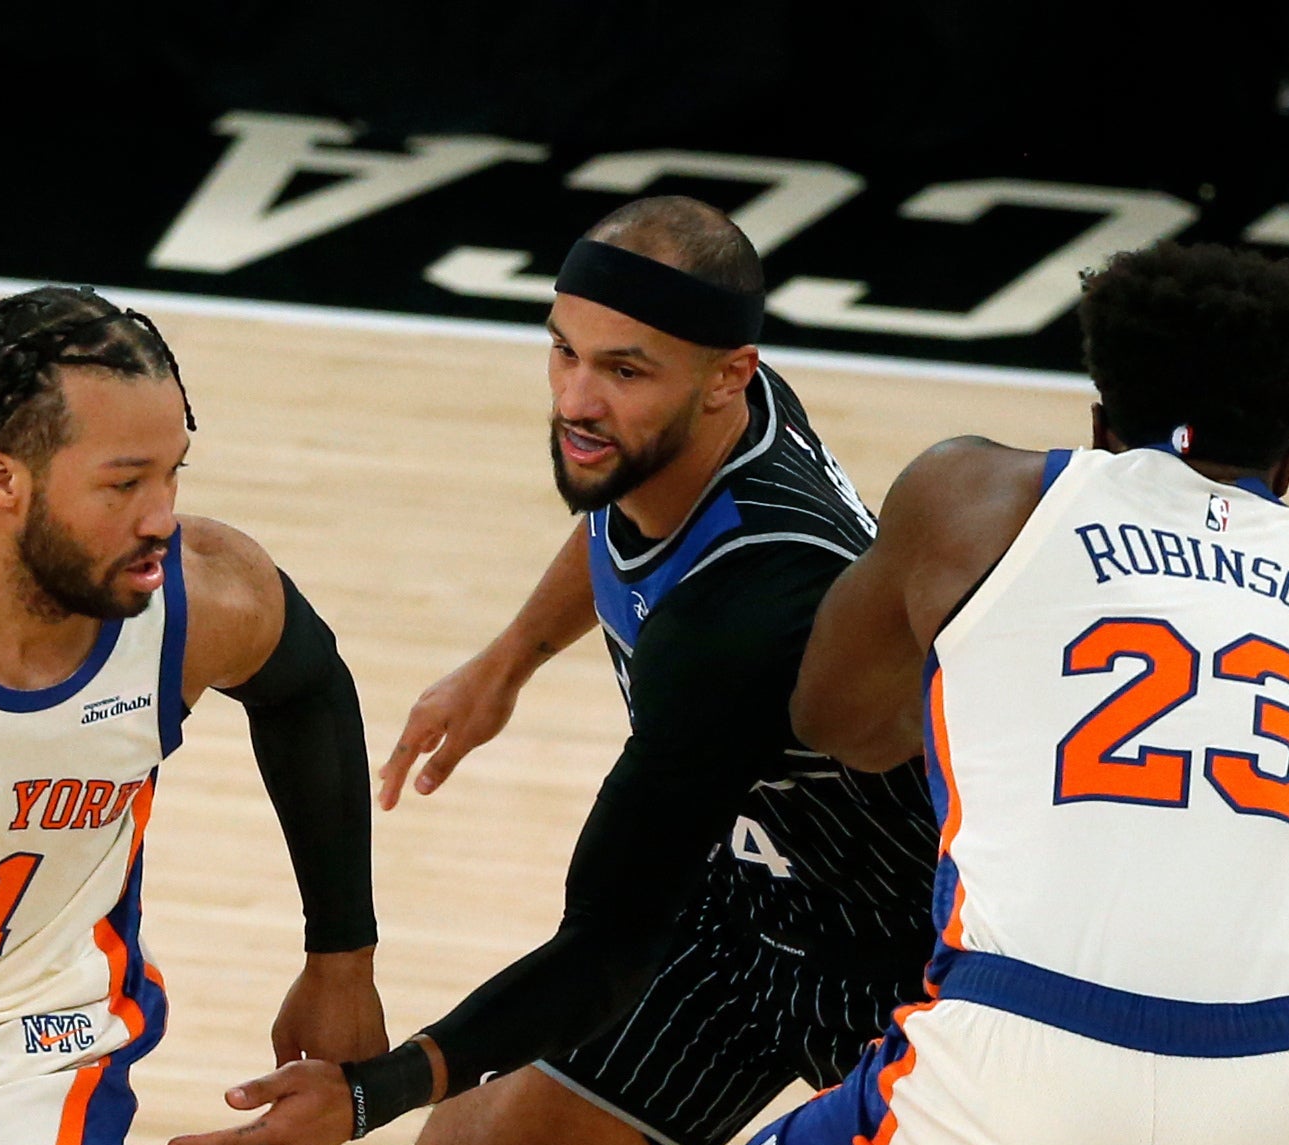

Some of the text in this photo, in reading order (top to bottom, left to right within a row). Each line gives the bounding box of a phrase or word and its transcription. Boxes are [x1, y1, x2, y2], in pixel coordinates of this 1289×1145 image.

[81, 693, 153, 724] abu dhabi
[731, 814, 793, 878] 4
[21, 1013, 94, 1053] NYC
